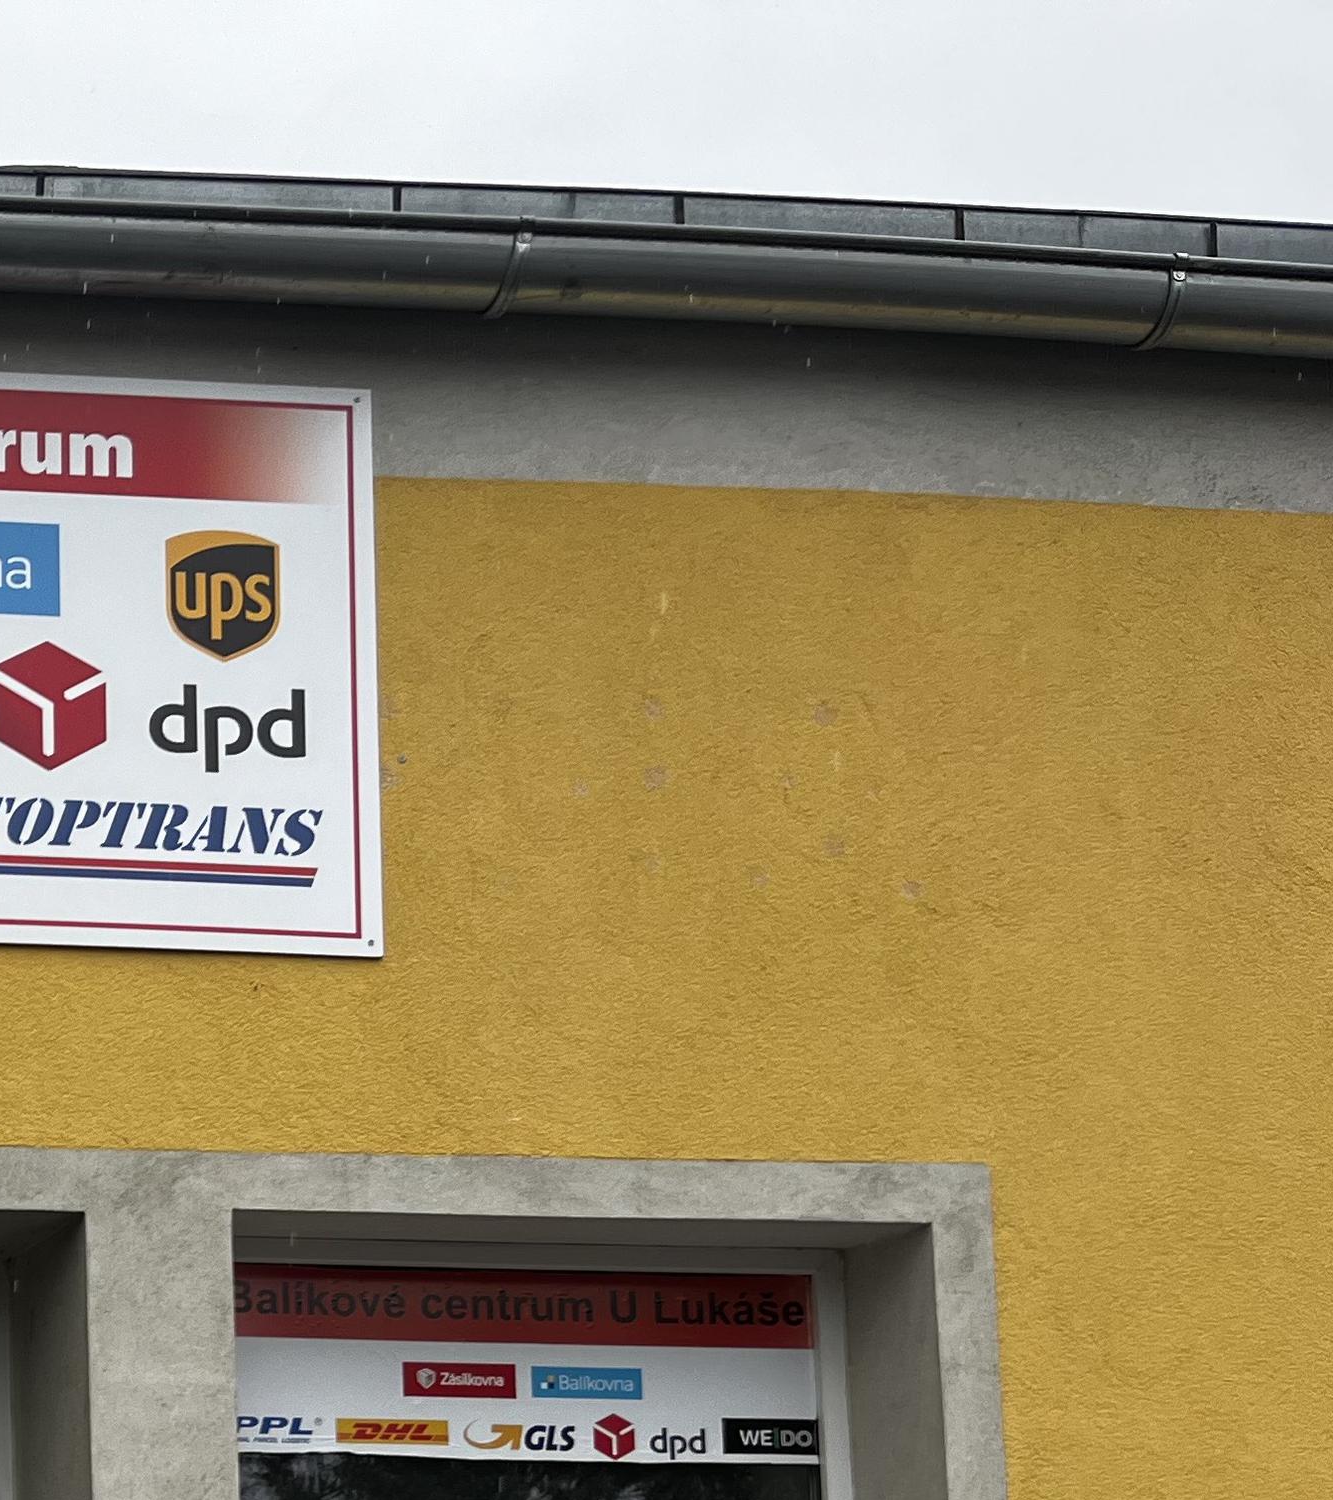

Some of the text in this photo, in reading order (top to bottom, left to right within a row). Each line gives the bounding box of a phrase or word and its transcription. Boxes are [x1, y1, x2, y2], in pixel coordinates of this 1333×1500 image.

[174, 570, 273, 641] ups
[148, 683, 307, 774] dpd
[421, 1289, 594, 1323] centrum
[609, 1289, 637, 1323] U
[655, 1291, 805, 1327] Lukáše
[440, 1370, 505, 1388] Zásilkovna
[558, 1373, 634, 1393] Balíkovna
[351, 1421, 436, 1442] DHL
[524, 1425, 575, 1451] GLS
[649, 1427, 706, 1460] dpd
